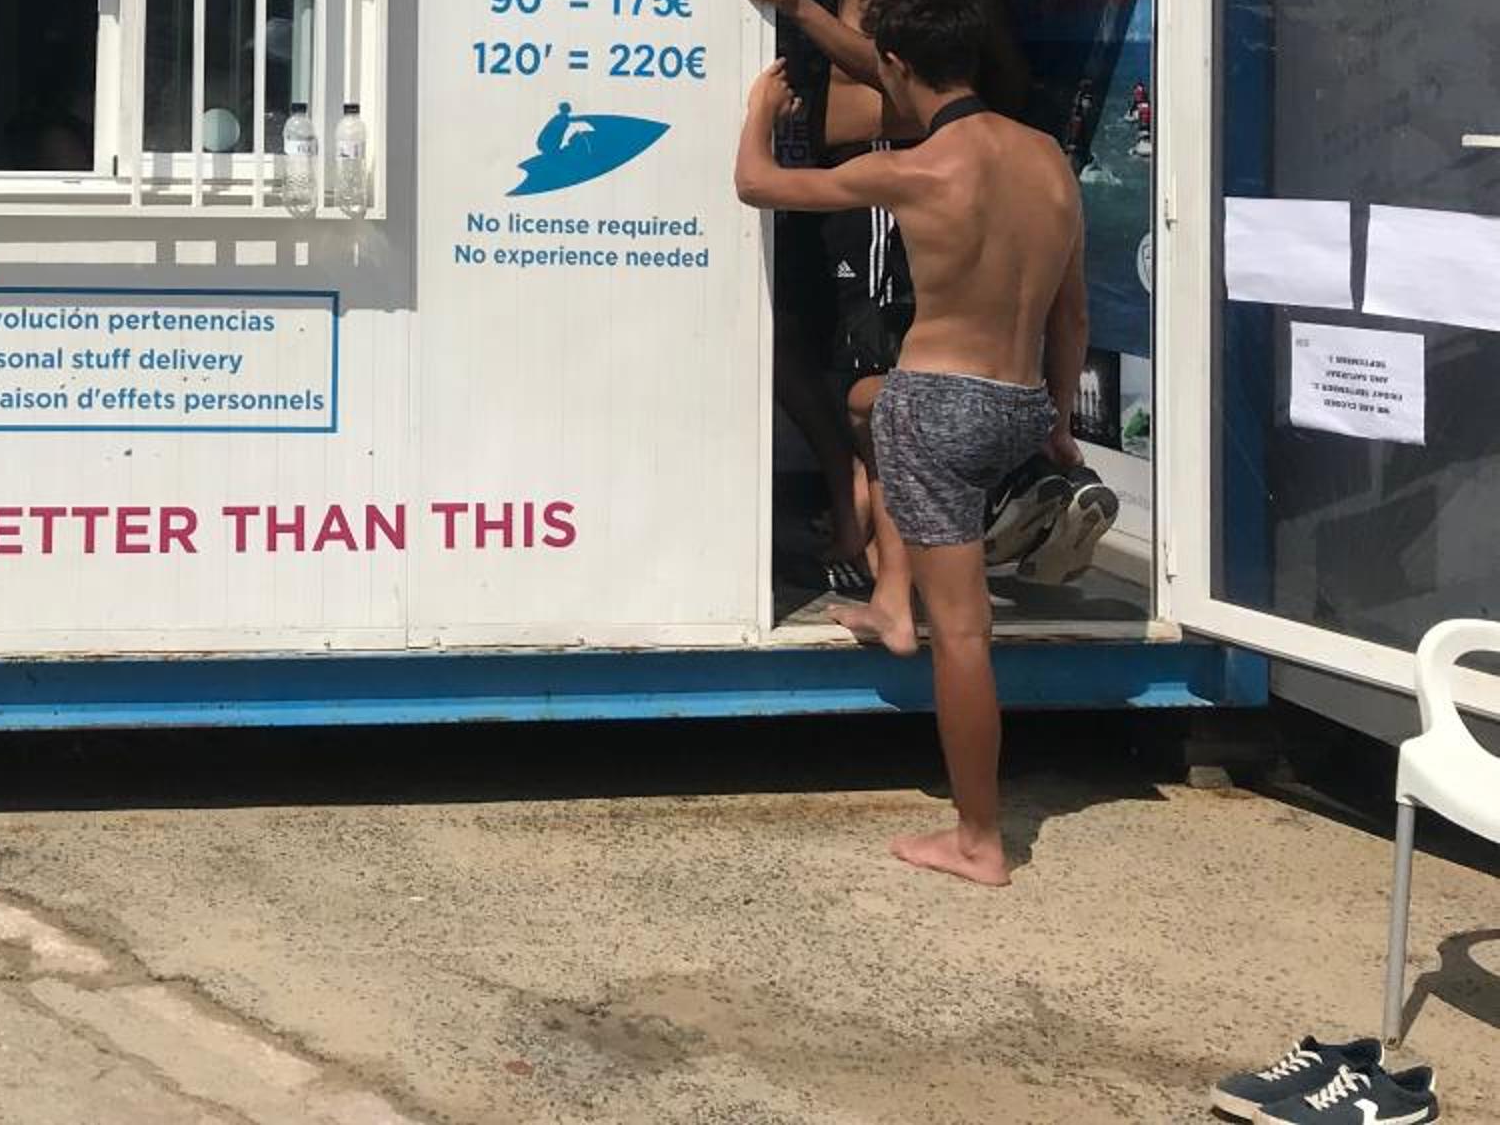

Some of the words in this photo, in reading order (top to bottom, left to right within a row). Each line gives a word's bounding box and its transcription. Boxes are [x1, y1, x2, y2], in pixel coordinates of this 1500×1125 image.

[473, 42, 552, 75] 120'
[569, 51, 588, 69] =
[609, 43, 706, 79] 220€
[468, 213, 500, 232] No
[509, 213, 590, 234] license
[598, 216, 703, 239] required.
[455, 245, 486, 263] No
[494, 246, 618, 267] experience
[626, 248, 708, 267] needed
[108, 309, 276, 334] pertenencias
[72, 348, 131, 369] stuff
[139, 349, 242, 374] delivery
[78, 388, 175, 409] d'effets
[185, 390, 324, 413] personnels
[222, 504, 405, 553] THAN
[431, 501, 576, 549] THIS
